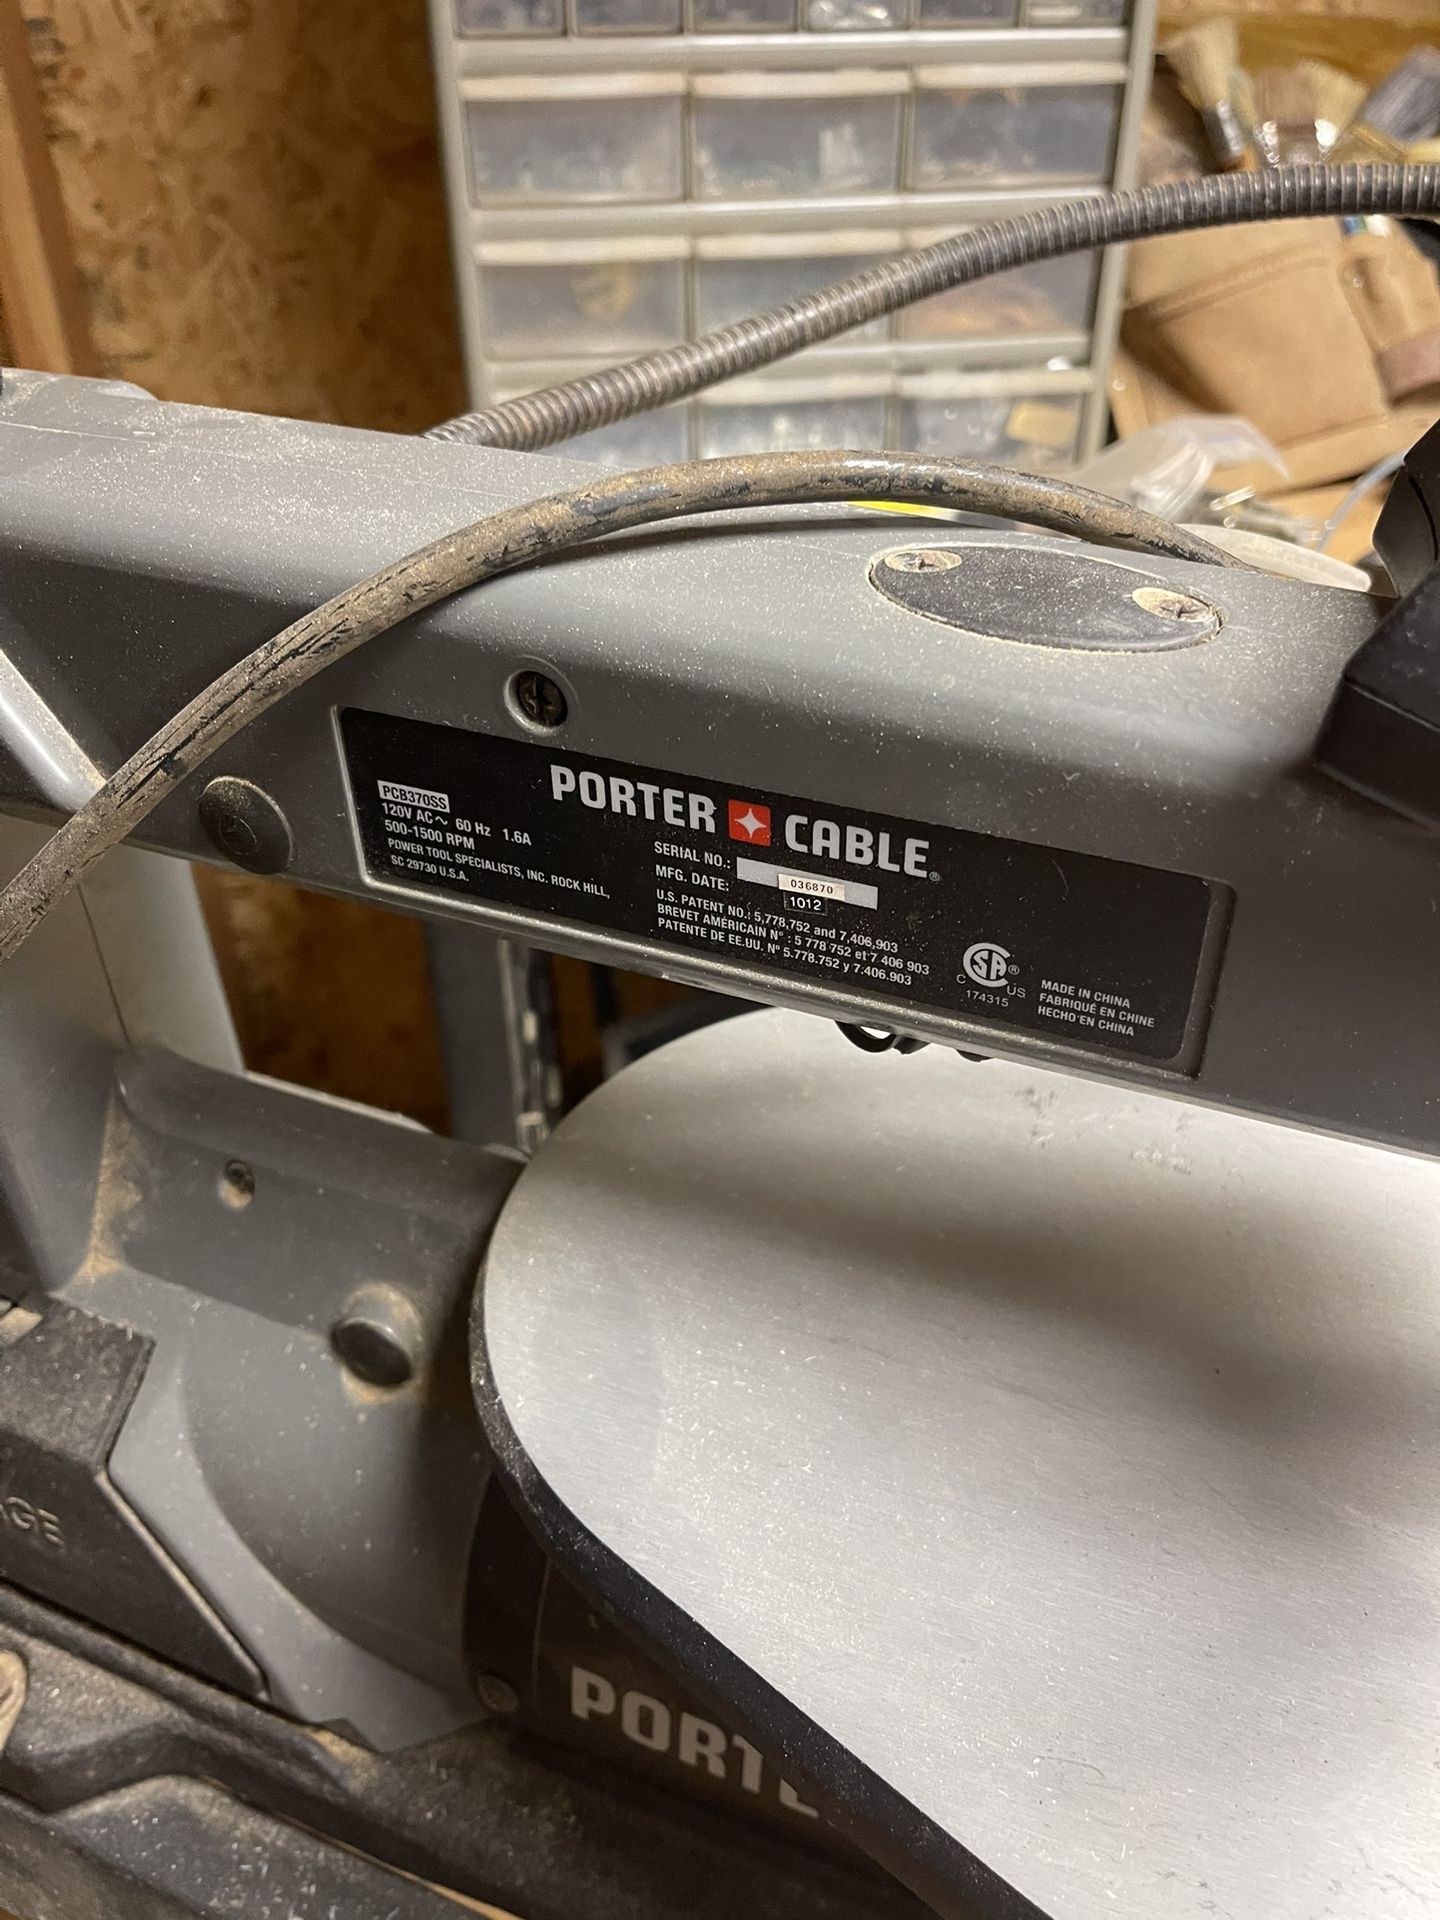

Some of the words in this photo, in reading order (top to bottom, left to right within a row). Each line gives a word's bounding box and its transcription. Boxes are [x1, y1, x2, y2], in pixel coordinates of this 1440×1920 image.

[382, 785, 447, 810] PCB370SS
[550, 764, 716, 834] PORTER
[381, 802, 412, 820] 120V
[455, 818, 472, 832] 60
[475, 822, 492, 837] Hz
[502, 828, 532, 846] 1.6A
[385, 819, 443, 843] 500-1500
[445, 833, 475, 850] RPM
[388, 837, 424, 855] POWER
[426, 846, 453, 862] TOOL
[455, 853, 525, 880] SPECIALISTS,
[527, 869, 549, 884] INC.
[551, 874, 581, 891] ROCK
[583, 881, 610, 899] HILL,
[390, 854, 404, 867] SC
[406, 858, 437, 875] 29730
[439, 866, 469, 882] U.S.A.
[654, 841, 700, 862] SERIAL
[704, 851, 731, 869] NO.:
[655, 864, 688, 882] MFG.
[691, 872, 729, 892] DATE:
[790, 879, 834, 895] 036870
[789, 896, 822, 911] 1012
[656, 888, 678, 903] U.S.
[681, 894, 724, 914] PATENT
[754, 911, 810, 934] 5,778,752
[813, 926, 836, 939] and
[839, 930, 898, 953] 7,406,903
[657, 903, 700, 922] BREVET
[805, 937, 827, 952] 778
[830, 943, 852, 958] 752
[855, 950, 867, 961] et
[881, 955, 904, 969] 406
[906, 961, 930, 975] 903
[658, 917, 707, 938] PATENTE
[710, 931, 725, 942] DE
[728, 935, 764, 951] EE.UU.
[783, 946, 840, 969] 5.778.752
[843, 962, 850, 973] y
[853, 963, 912, 986] 7.406.903
[965, 989, 1009, 1008] 174315
[1006, 984, 1026, 998] US
[1040, 979, 1076, 996] MADE
[1078, 988, 1091, 999] IN
[1093, 991, 1131, 1009] CHINA
[1038, 1005, 1076, 1023] HECHO
[1079, 1015, 1095, 1027] EN
[1098, 1019, 1134, 1037] CHINA
[1100, 1006, 1116, 1019] EN
[1118, 1010, 1155, 1028] CHINE
[0, 1496, 65, 1548] GE
